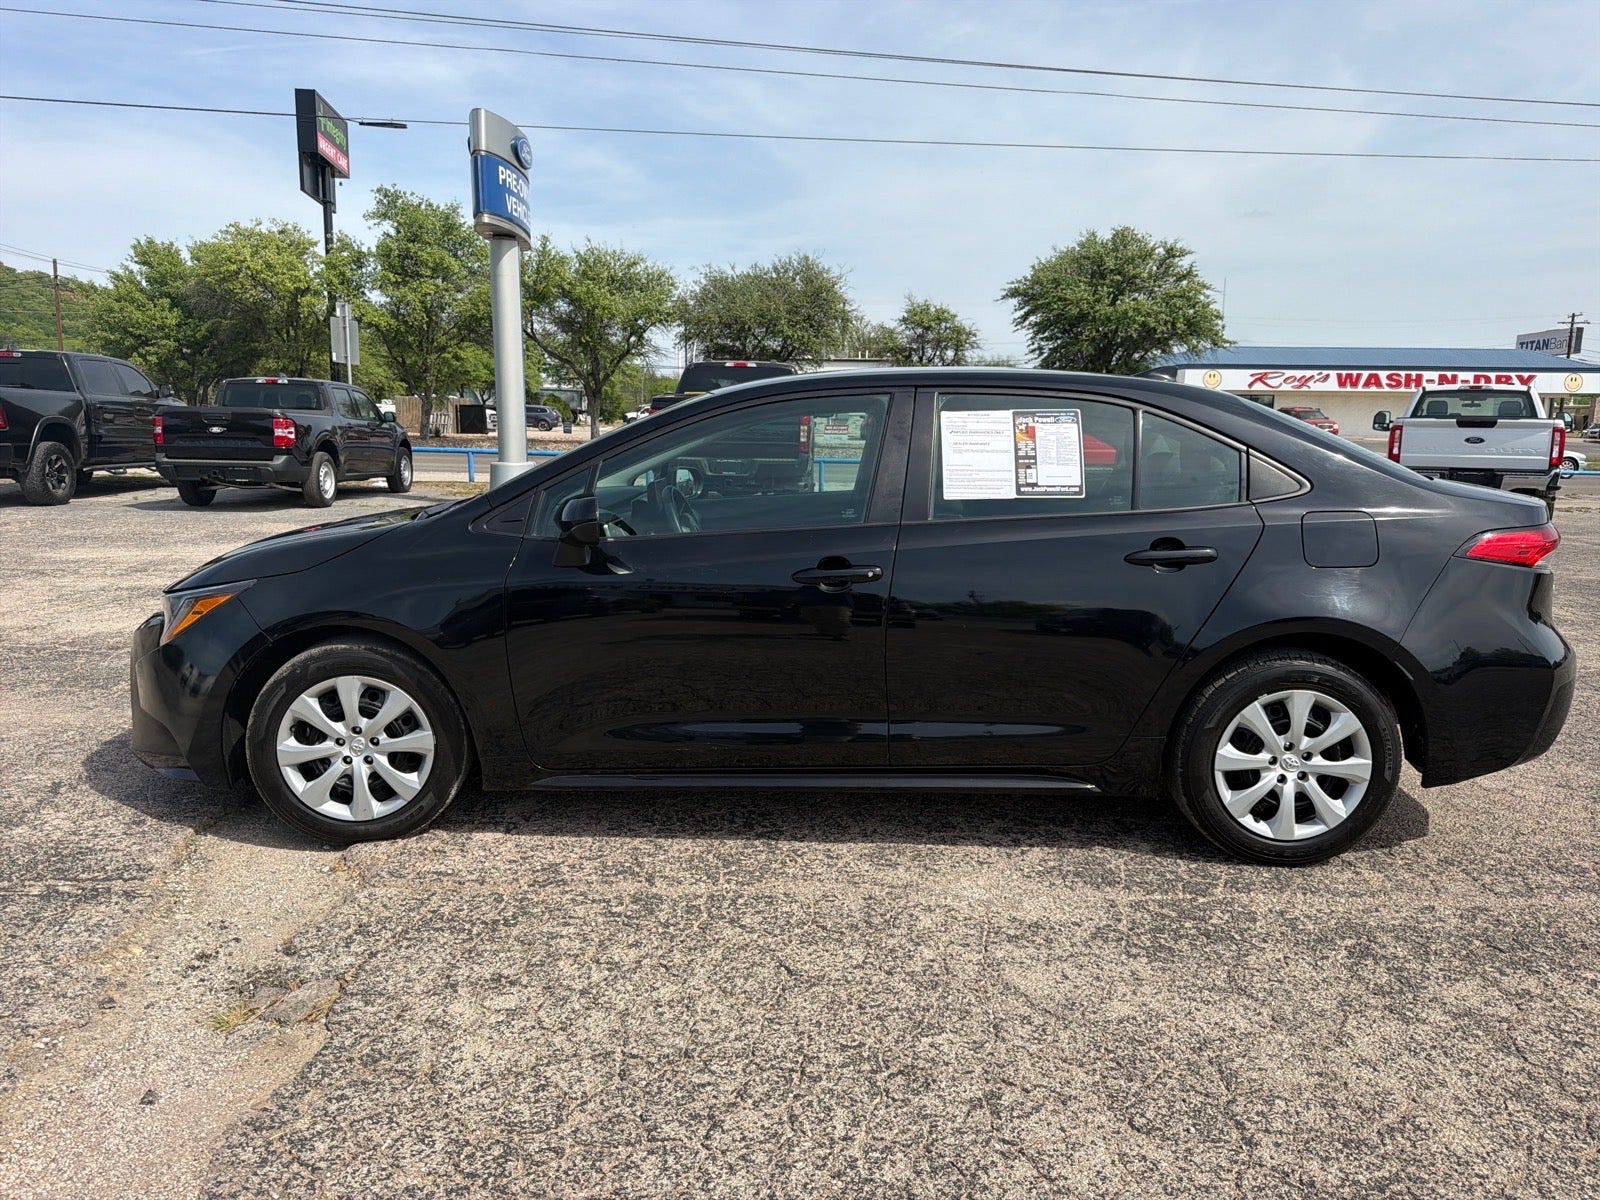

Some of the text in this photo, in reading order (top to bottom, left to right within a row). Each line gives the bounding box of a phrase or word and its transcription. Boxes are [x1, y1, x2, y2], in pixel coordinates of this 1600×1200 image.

[319, 140, 348, 170] URGENT CARE
[1519, 337, 1569, 351] TITANBan
[1247, 371, 1537, 389] Roy's WASH-N-DRY
